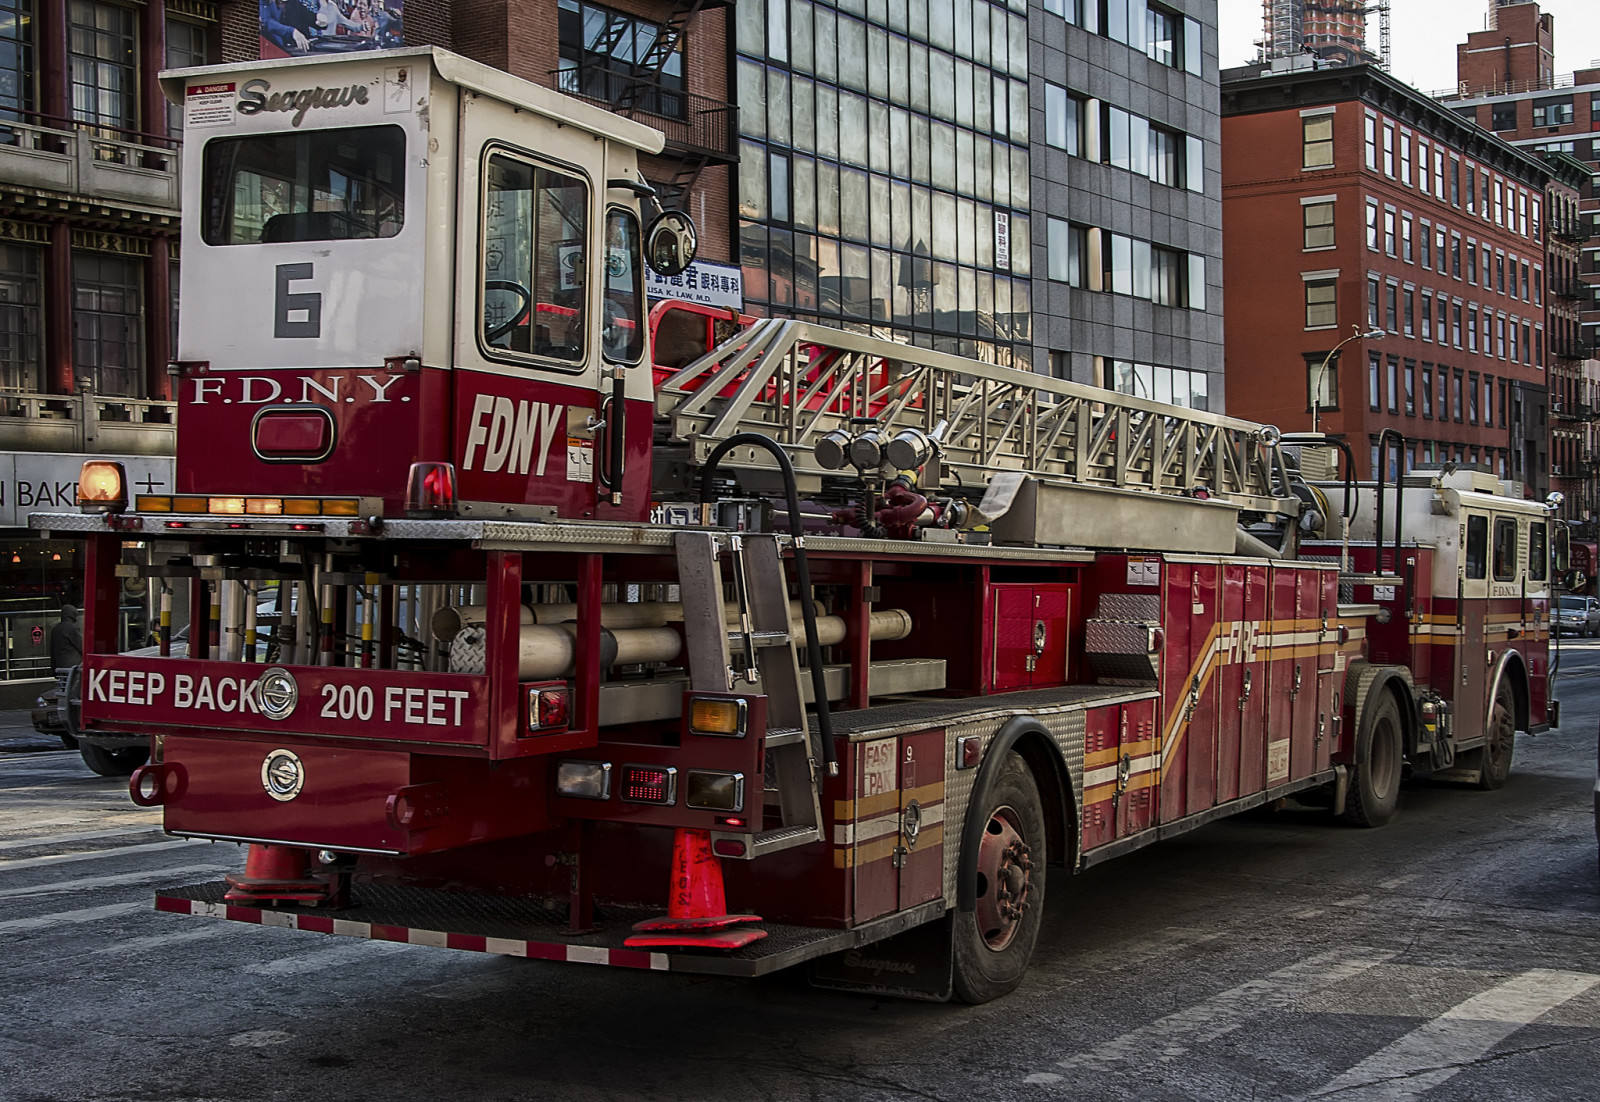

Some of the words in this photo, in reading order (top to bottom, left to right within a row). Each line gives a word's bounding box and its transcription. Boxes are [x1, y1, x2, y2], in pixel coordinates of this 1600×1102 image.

[204, 84, 229, 93] DANGER
[236, 78, 369, 128] Seagrave
[274, 262, 322, 339] 6
[647, 286, 664, 295] LISA
[666, 289, 674, 297] K.
[676, 291, 694, 301] LAW,
[695, 294, 712, 303] M.D.
[190, 374, 411, 405] F.D.N.Y.
[462, 393, 564, 477] FDNY
[1227, 620, 1260, 664] FIRE
[88, 668, 166, 705] KEEP
[174, 674, 261, 714] BACK
[320, 683, 374, 721] 200
[384, 686, 469, 726] FEET
[866, 743, 895, 769] FAST
[906, 745, 913, 761] 9
[843, 950, 916, 977] Seagrave
